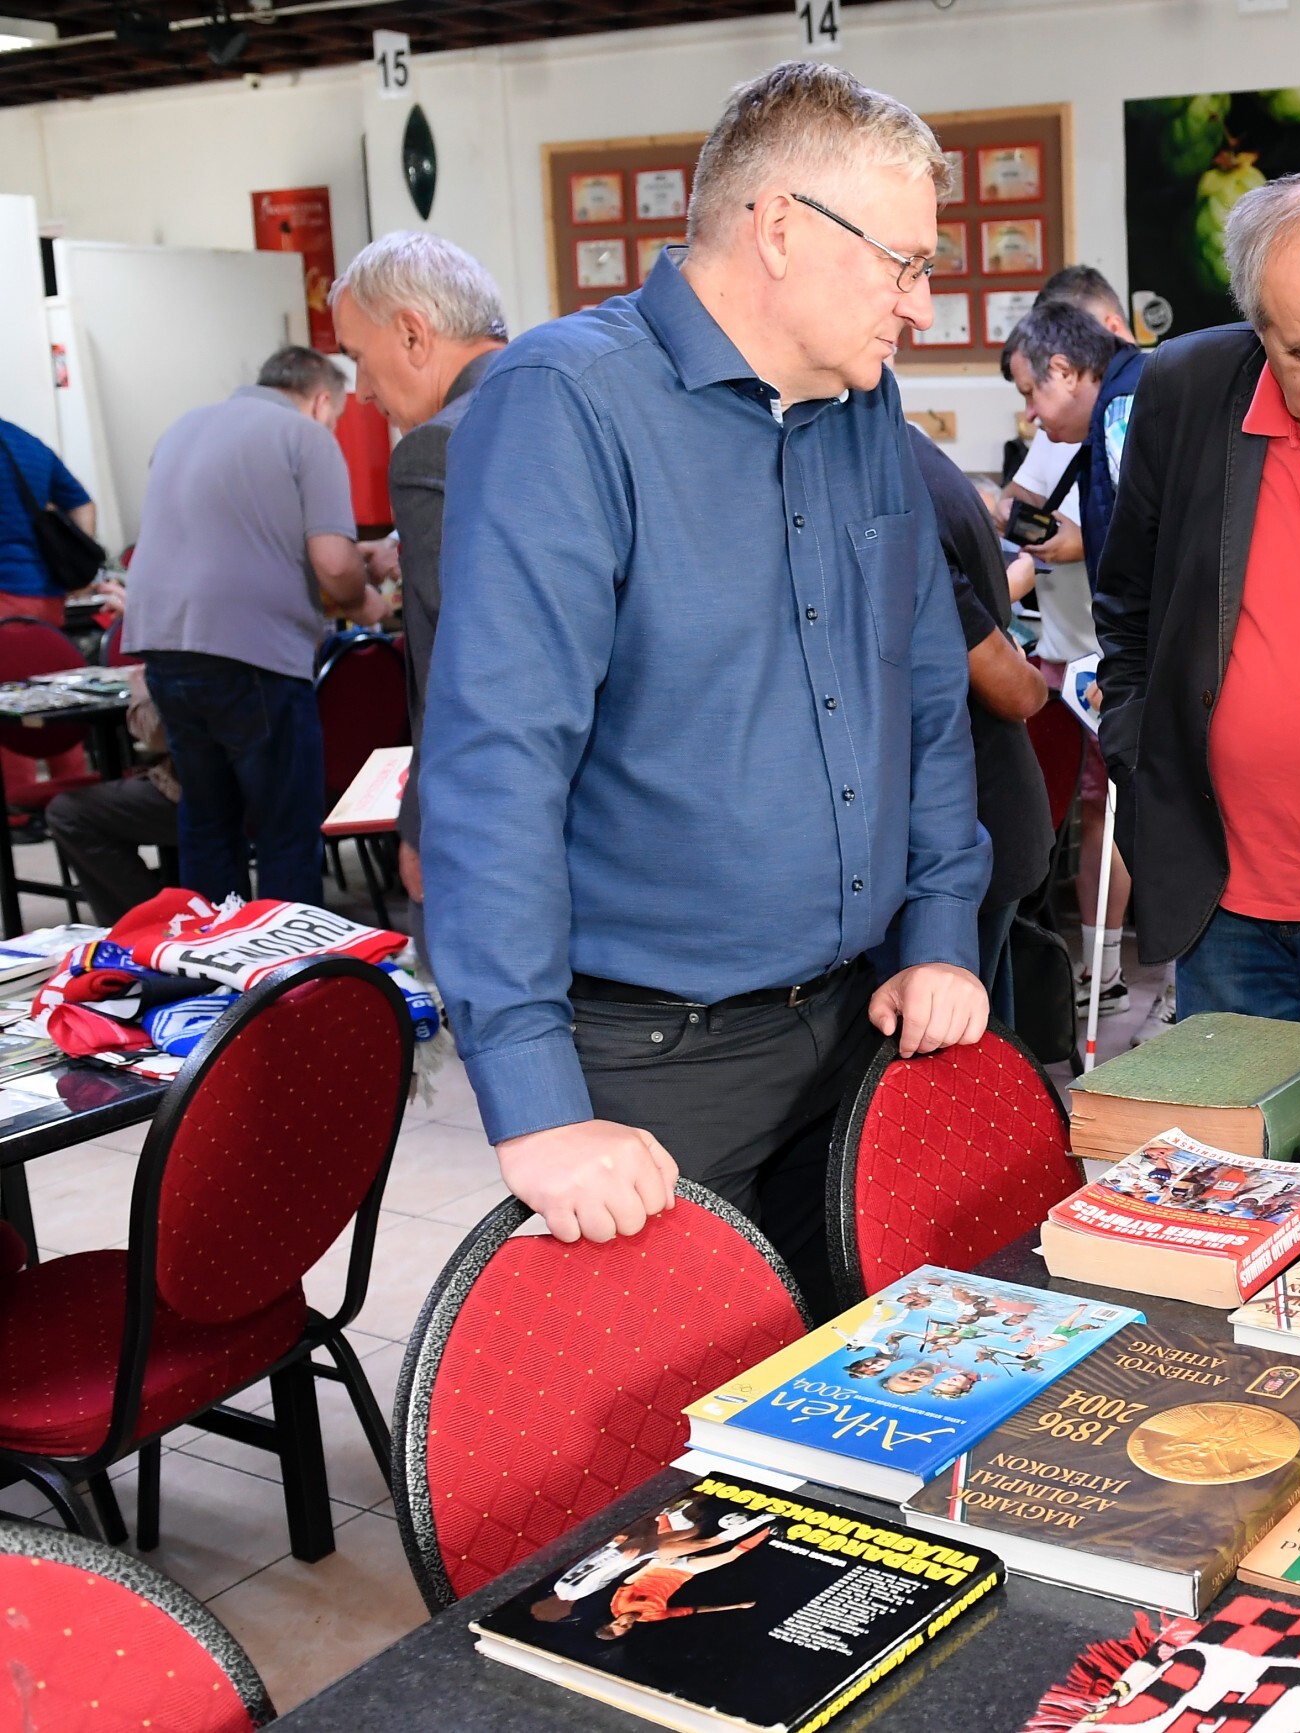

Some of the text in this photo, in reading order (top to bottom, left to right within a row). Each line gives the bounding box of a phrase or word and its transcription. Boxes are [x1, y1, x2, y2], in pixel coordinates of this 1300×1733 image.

[800, 0, 839, 44] 14
[377, 50, 408, 88] 15
[1263, 1163, 1299, 1172] DAVID
[1068, 1199, 1165, 1236] OLYMPICS
[1072, 1213, 1226, 1249] THE COMPLETE BOOK OF THE
[1168, 1220, 1249, 1246] SUMMER
[1240, 1250, 1274, 1288] SUMMER
[1113, 1354, 1230, 1388] ATHÉNTÓL
[1127, 1340, 1226, 1369] ATHÉNIG
[791, 1377, 857, 1403] 2004
[1056, 1389, 1150, 1423] 2004
[770, 1391, 956, 1451] Athén
[1027, 1412, 1121, 1447] 1896
[967, 1468, 1118, 1513] AZ OLIMPIAI
[986, 1452, 1131, 1496] JÁTÉKOKON
[945, 1487, 1085, 1529] MAGYAROK
